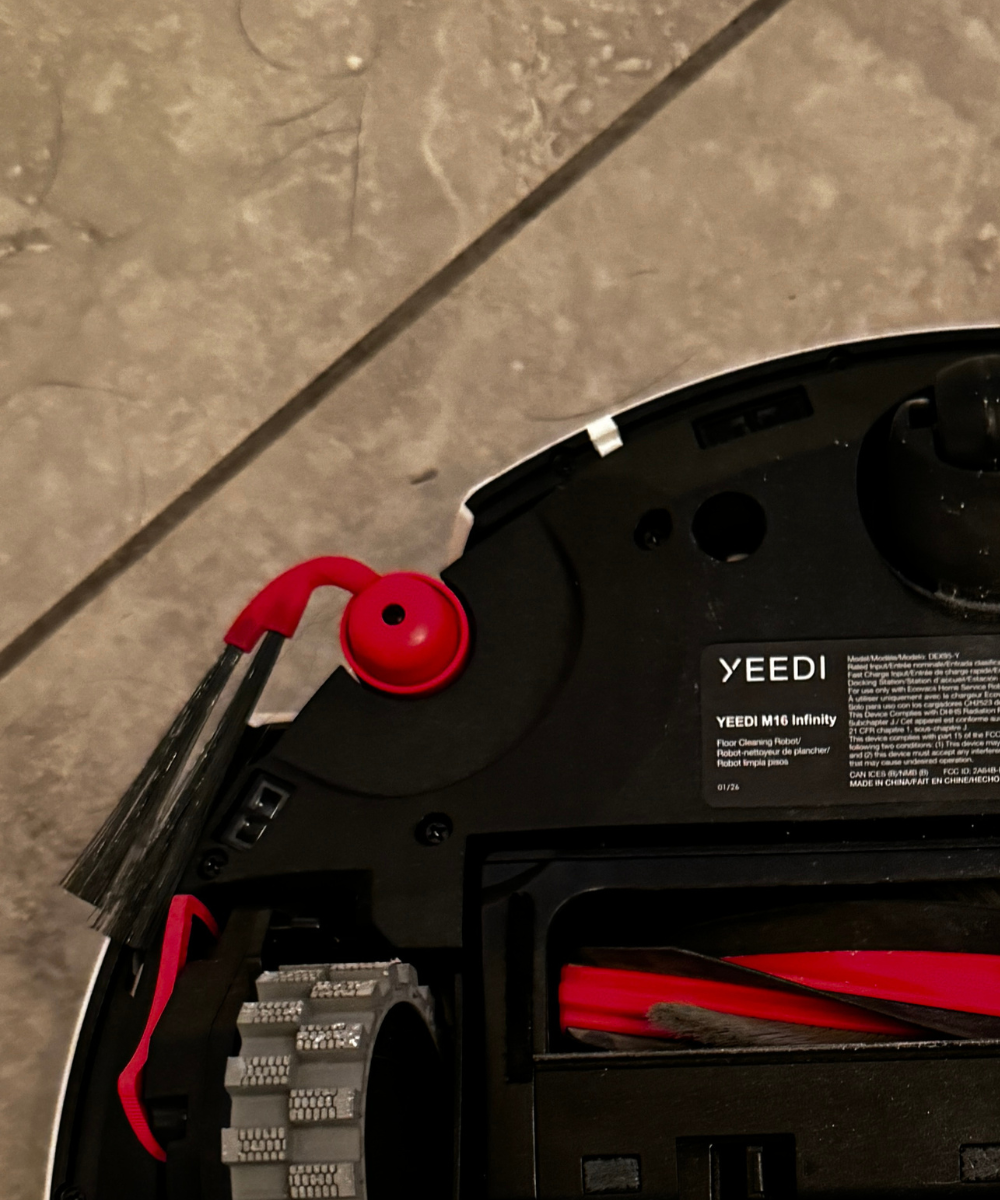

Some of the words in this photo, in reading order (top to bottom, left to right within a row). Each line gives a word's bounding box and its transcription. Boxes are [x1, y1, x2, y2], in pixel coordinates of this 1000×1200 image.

[719, 655, 826, 682] YEEDI
[716, 716, 758, 728] YEEDI
[762, 715, 788, 727] M16
[792, 714, 837, 728] Infinity
